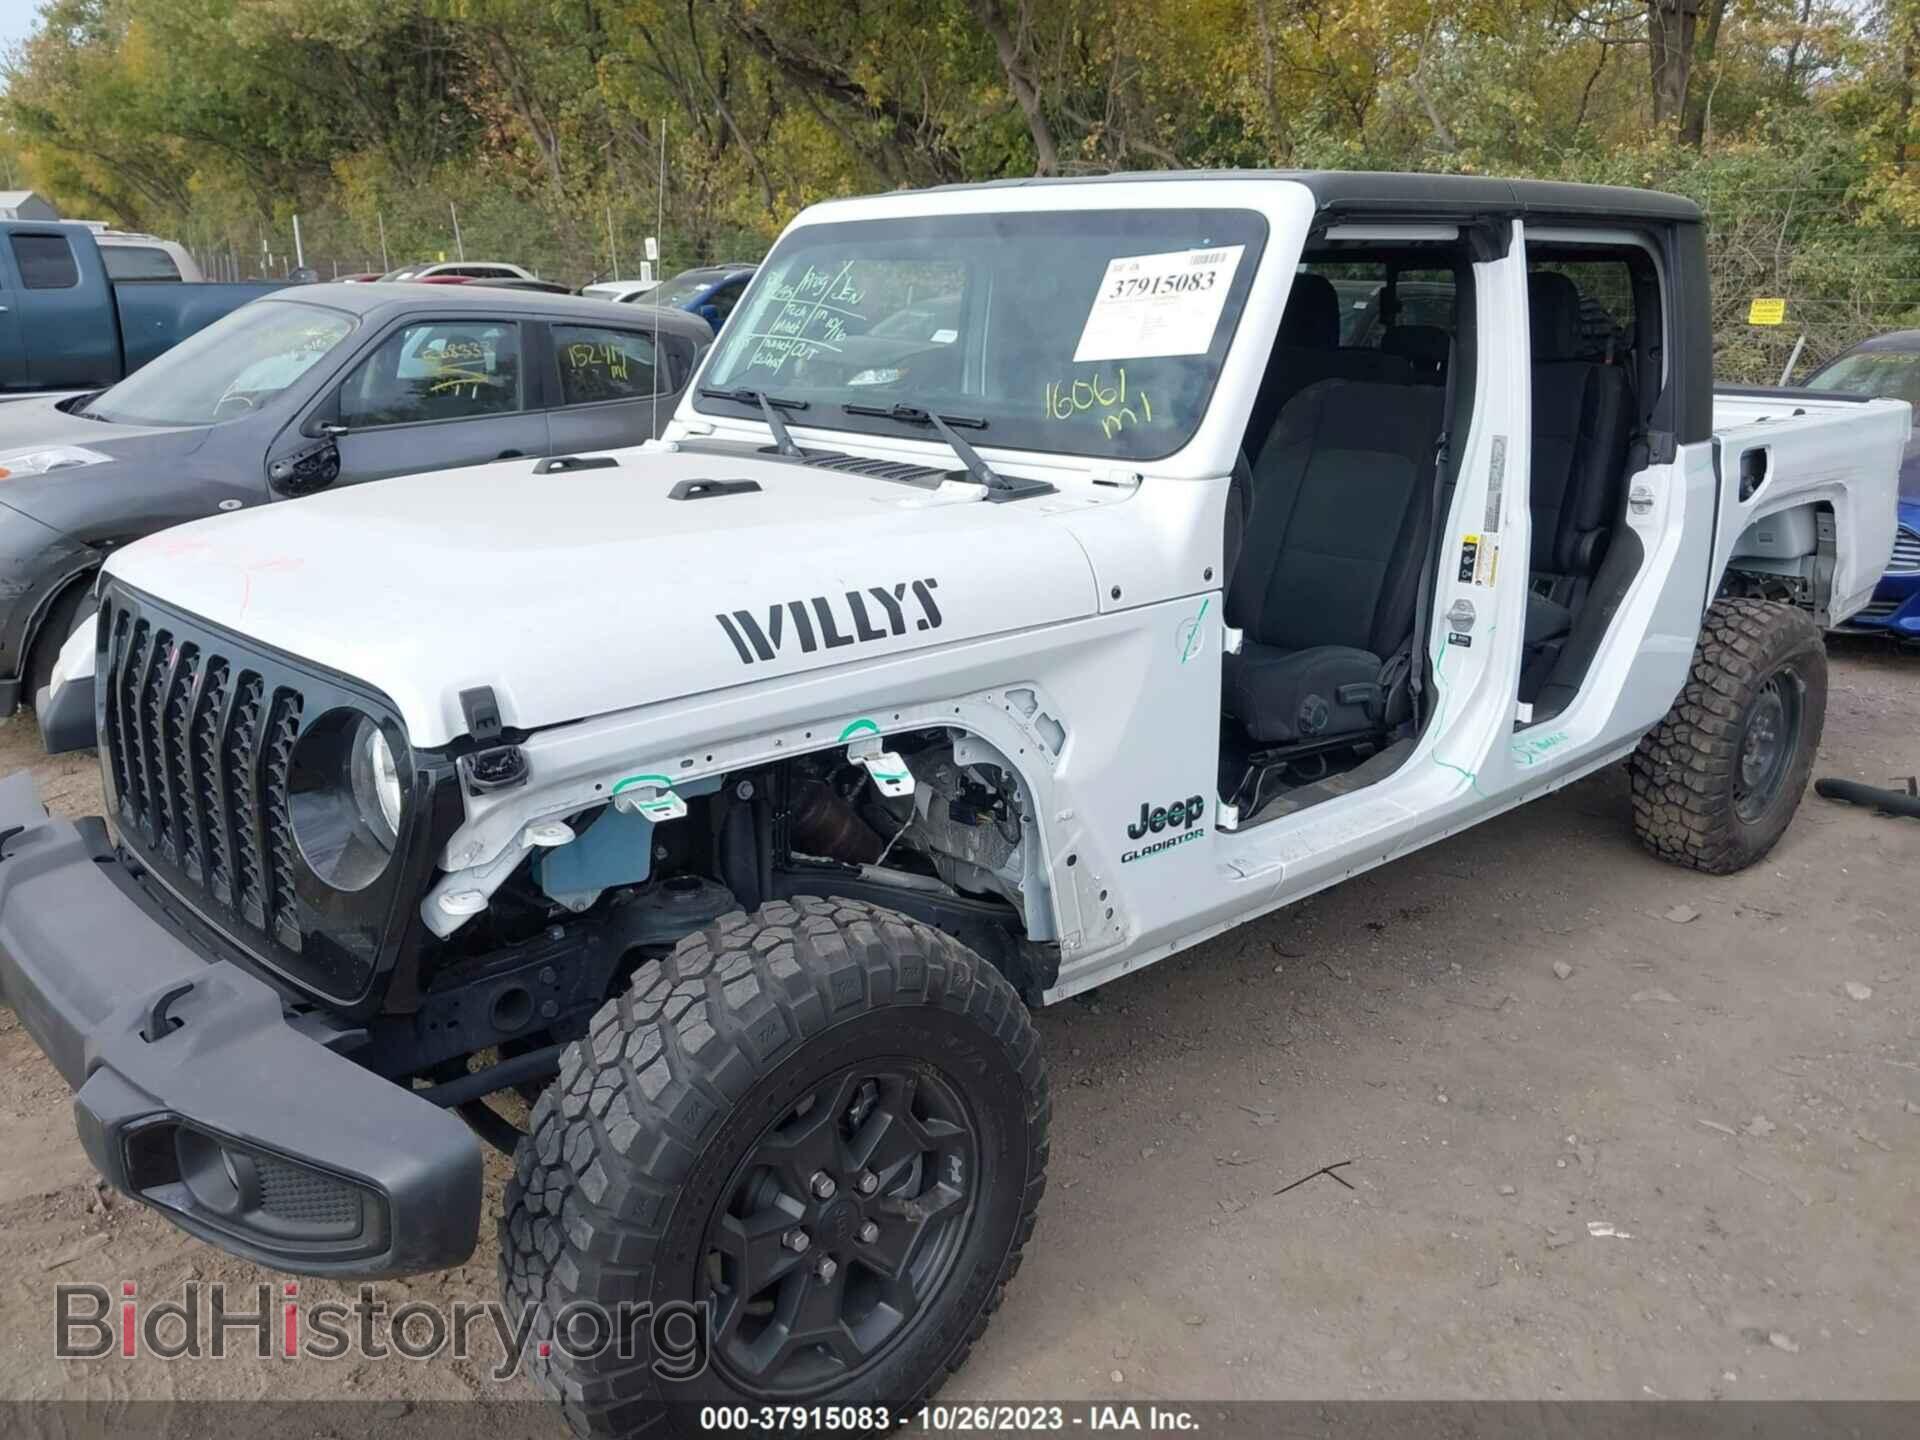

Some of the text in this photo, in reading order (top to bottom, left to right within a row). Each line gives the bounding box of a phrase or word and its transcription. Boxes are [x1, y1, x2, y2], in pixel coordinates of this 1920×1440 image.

[1109, 270, 1216, 299] 37915083
[1045, 367, 1126, 420] 16061
[715, 577, 943, 665] WILLYS
[1127, 794, 1204, 840] Jeep
[1120, 828, 1204, 864] GLADIATOR
